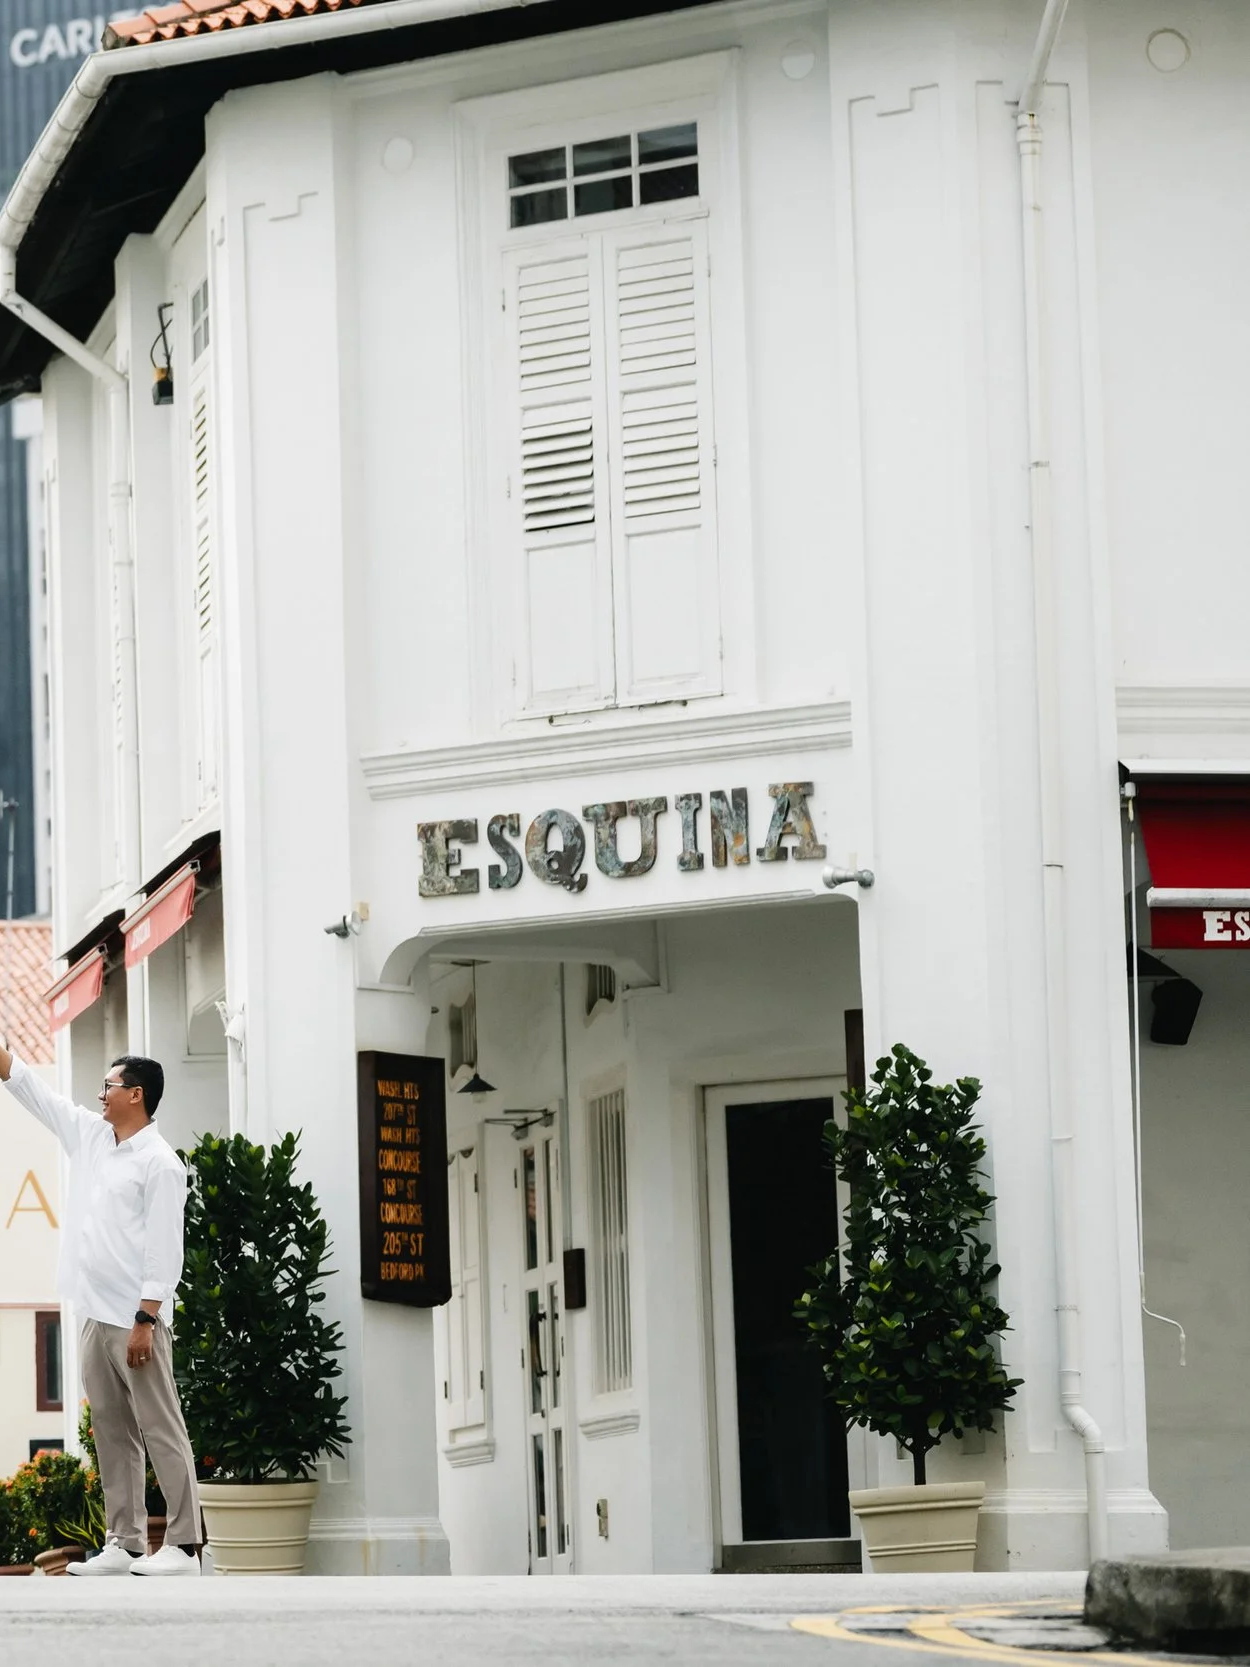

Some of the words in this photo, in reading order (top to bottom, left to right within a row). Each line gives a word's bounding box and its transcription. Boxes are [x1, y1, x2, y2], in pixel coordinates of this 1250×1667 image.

[417, 781, 827, 898] ESQUINA
[406, 1103, 416, 1125] ST
[378, 1148, 421, 1174] CONCOURSE
[406, 1179, 416, 1200] ST
[380, 1201, 423, 1226] CONCOURSE
[410, 1232, 424, 1256] ST
[380, 1261, 414, 1281] BEDFORD
